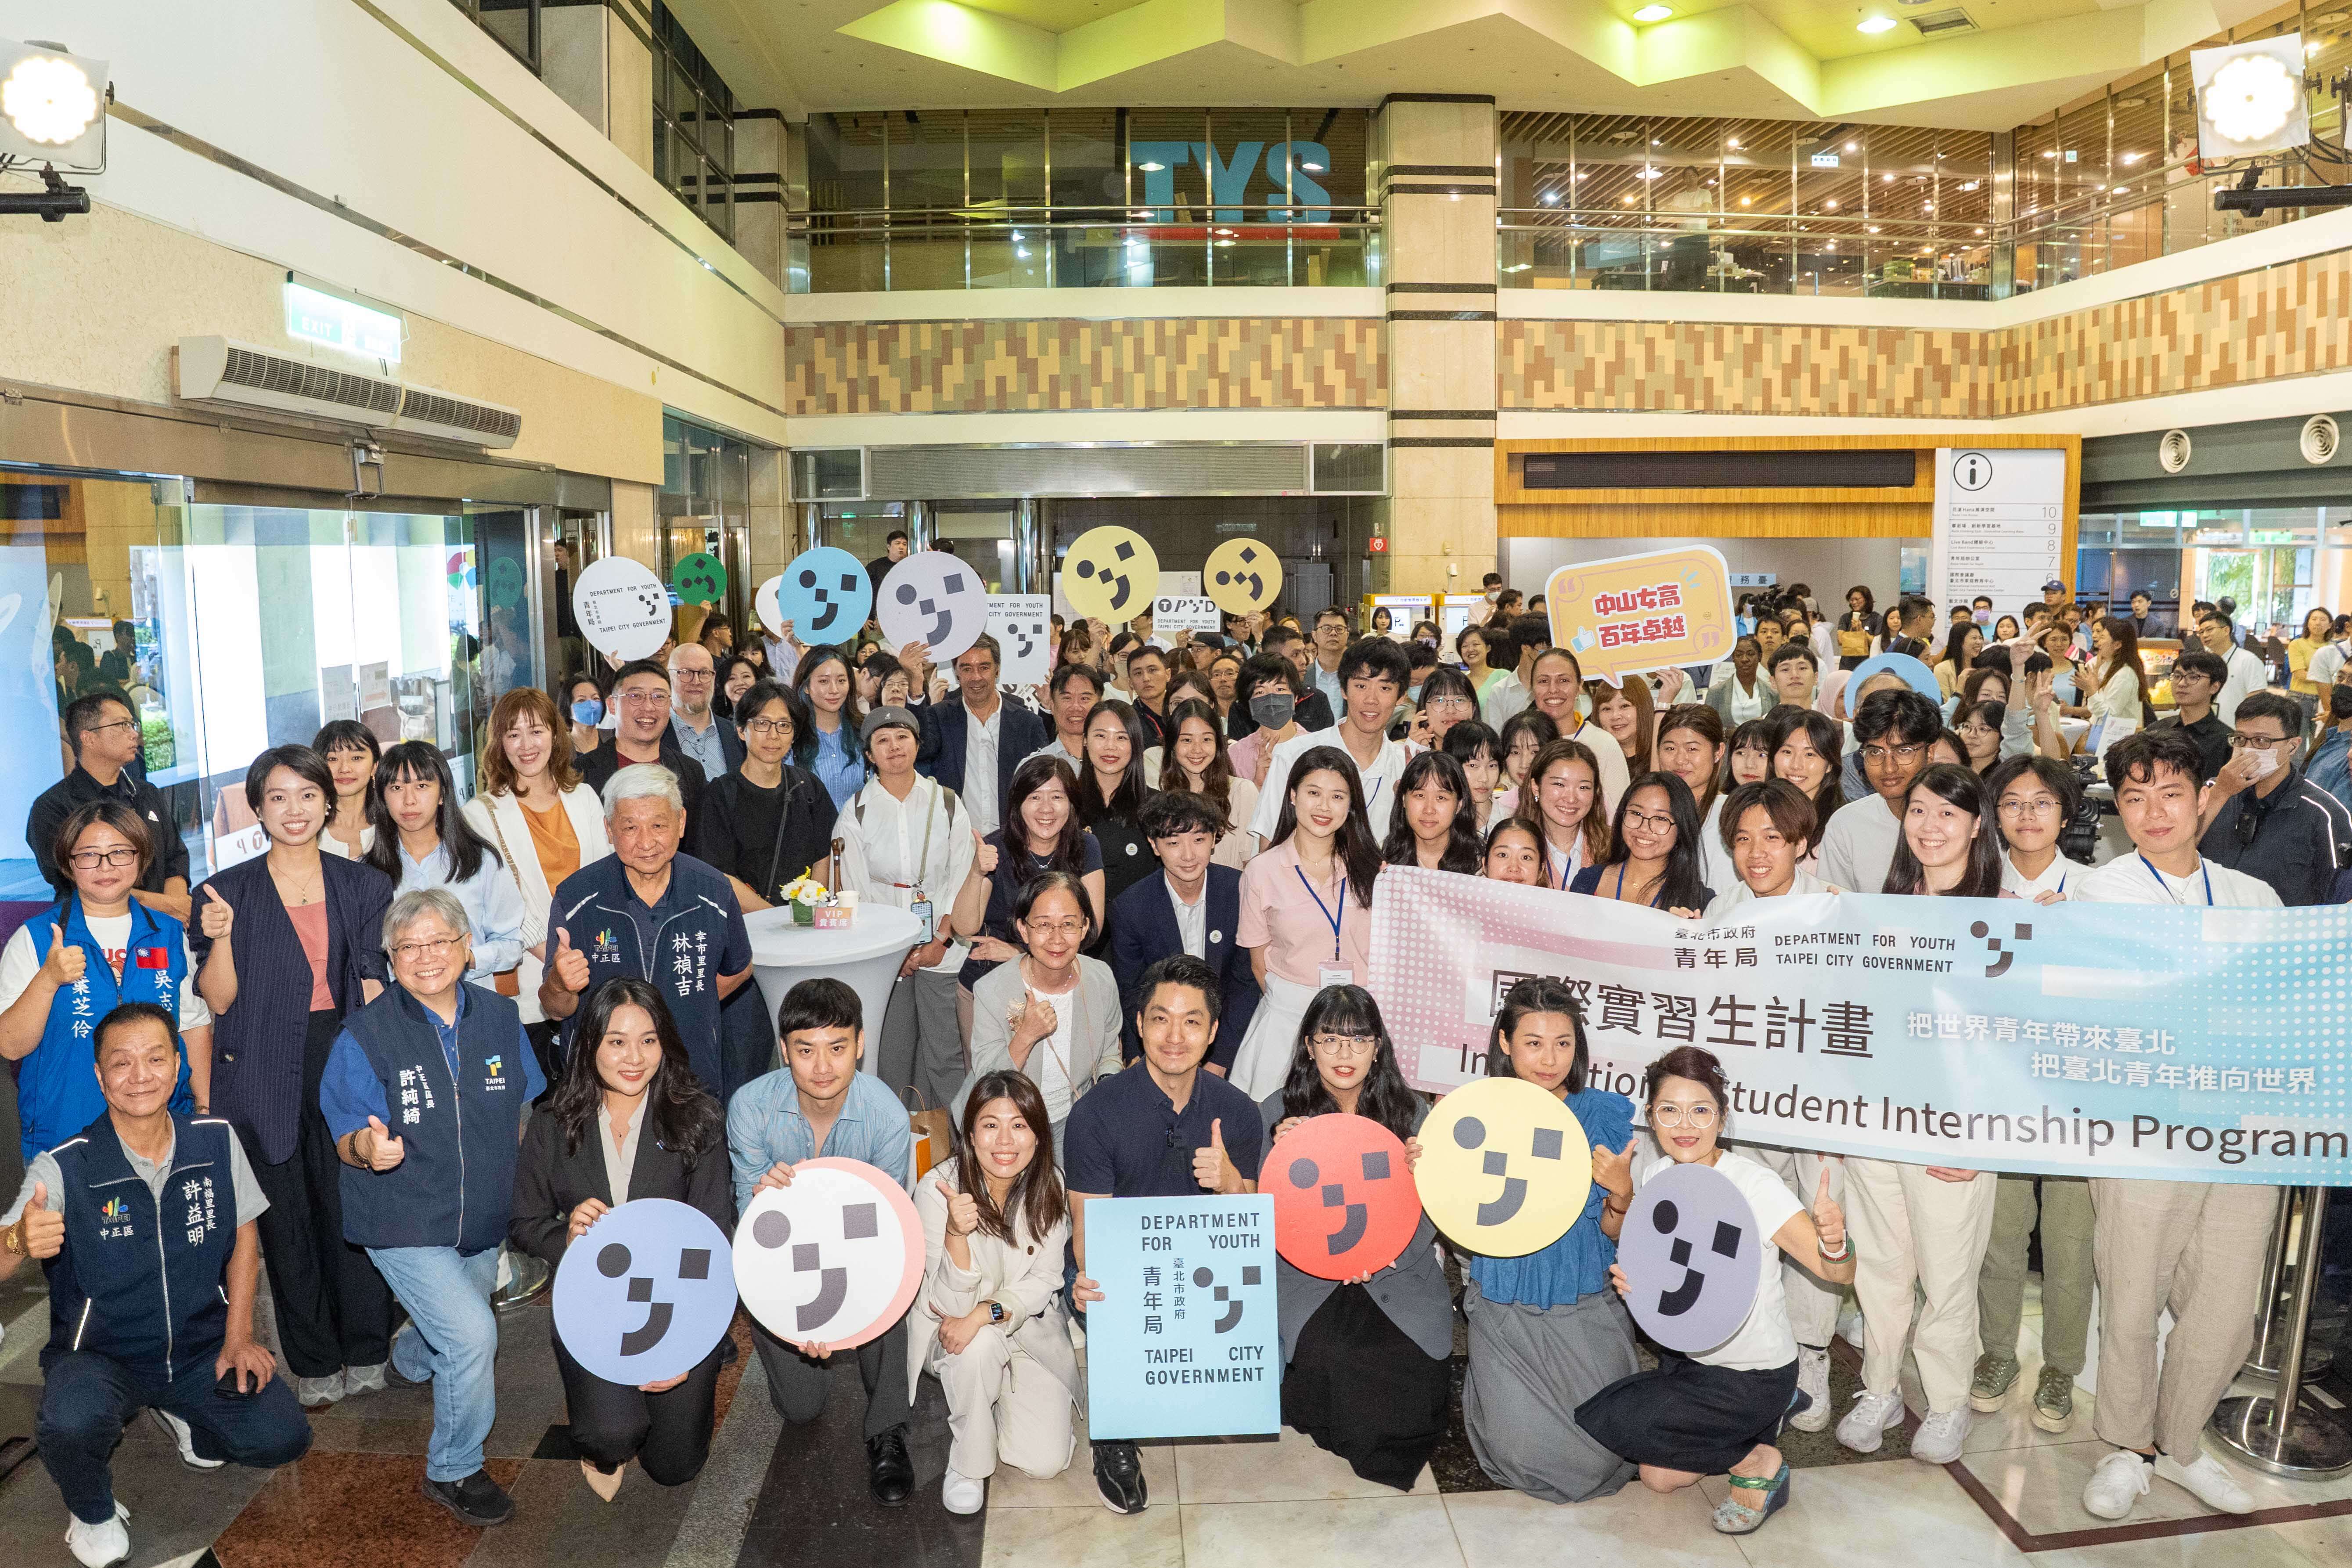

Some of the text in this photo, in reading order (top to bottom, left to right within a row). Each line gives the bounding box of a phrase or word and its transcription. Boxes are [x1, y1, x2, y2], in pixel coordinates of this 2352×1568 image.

[1130, 141, 1331, 223] TYS
[302, 317, 332, 337] EXIT
[2042, 507, 2057, 518] 10
[2048, 523, 2056, 534] 9
[2047, 540, 2055, 551] 8
[2047, 556, 2055, 568] 7
[1729, 576, 1767, 584] 務臺
[2046, 573, 2053, 581] 6
[590, 588, 623, 597] DEPARTMENT
[1595, 585, 1680, 616] 中山女高
[583, 601, 595, 626] 青年局
[633, 618, 666, 628] GOVERNMENT
[1599, 616, 1685, 647] 百年卓越
[819, 918, 847, 927] 貴賓席
[1675, 925, 1756, 940] 臺北市政府
[1775, 932, 1956, 951] DEPARTMENT FOR YOUTH
[591, 952, 620, 963] 中正區
[672, 932, 693, 997] 林禎吉
[695, 930, 708, 992] 幸市里里長
[1674, 947, 1758, 969] 青年局
[1776, 954, 1953, 973] TAIPEI CITY GOVERNMENT
[1907, 1010, 2176, 1056] 把世界青年帶來臺北
[2031, 1052, 2317, 1095] 把臺北青年推向世界
[1732, 1081, 2348, 1164] tudent Internship Program
[202, 1177, 216, 1231] 南福里里長
[101, 1215, 130, 1224] TAIPEI
[182, 1180, 205, 1247] 許益明
[1142, 1212, 1260, 1230] DEPARTMENT
[100, 1226, 134, 1240] 中正區
[1142, 1234, 1261, 1251] FOR YOUTH
[1173, 1258, 1186, 1319] 臺北市政府
[1143, 1266, 1163, 1334] 青年局
[1145, 1346, 1264, 1363] TAIPEI CITY
[1145, 1367, 1264, 1385] GOVERNMENT
